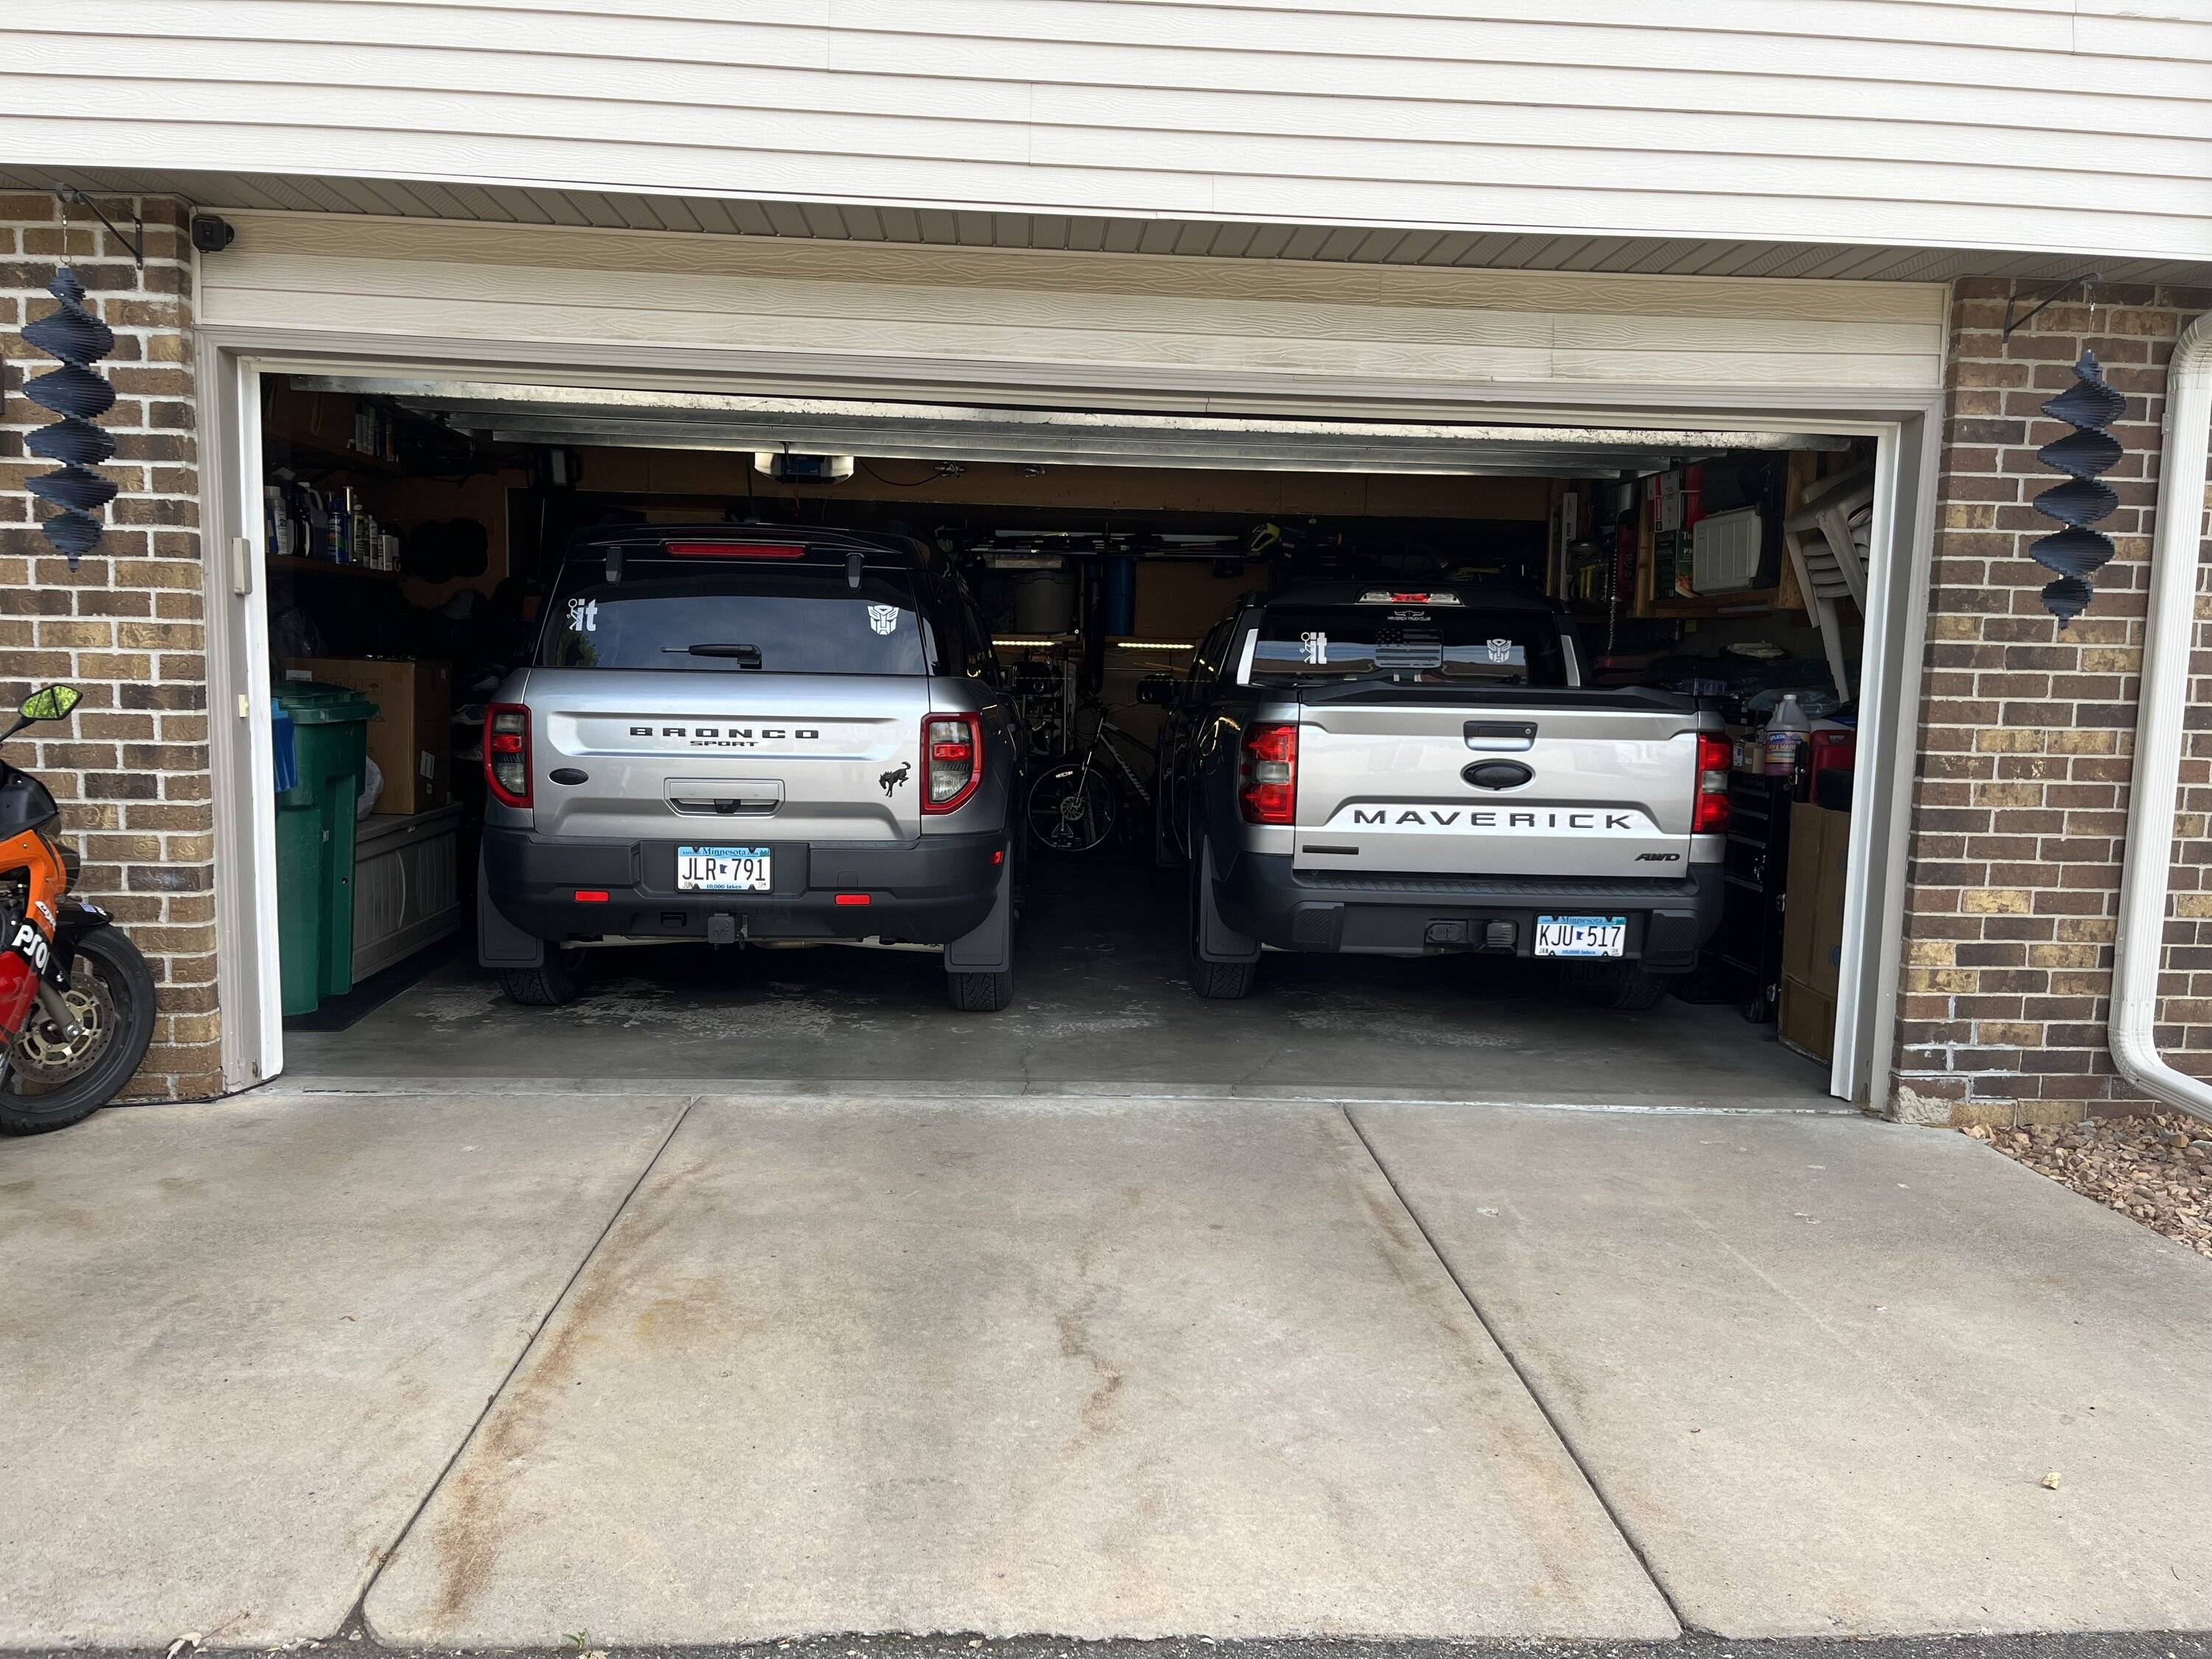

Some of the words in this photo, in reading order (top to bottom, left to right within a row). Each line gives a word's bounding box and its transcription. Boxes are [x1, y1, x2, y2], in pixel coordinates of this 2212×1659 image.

[630, 727, 819, 739] BRONCO
[1354, 810, 1632, 830] MAVERICK
[703, 847, 746, 856] Minnesota
[1634, 853, 1680, 861] AWD
[682, 858, 716, 880] JLR
[731, 858, 765, 881] 791
[1539, 925, 1574, 946] KJU
[1587, 926, 1621, 947] 517
